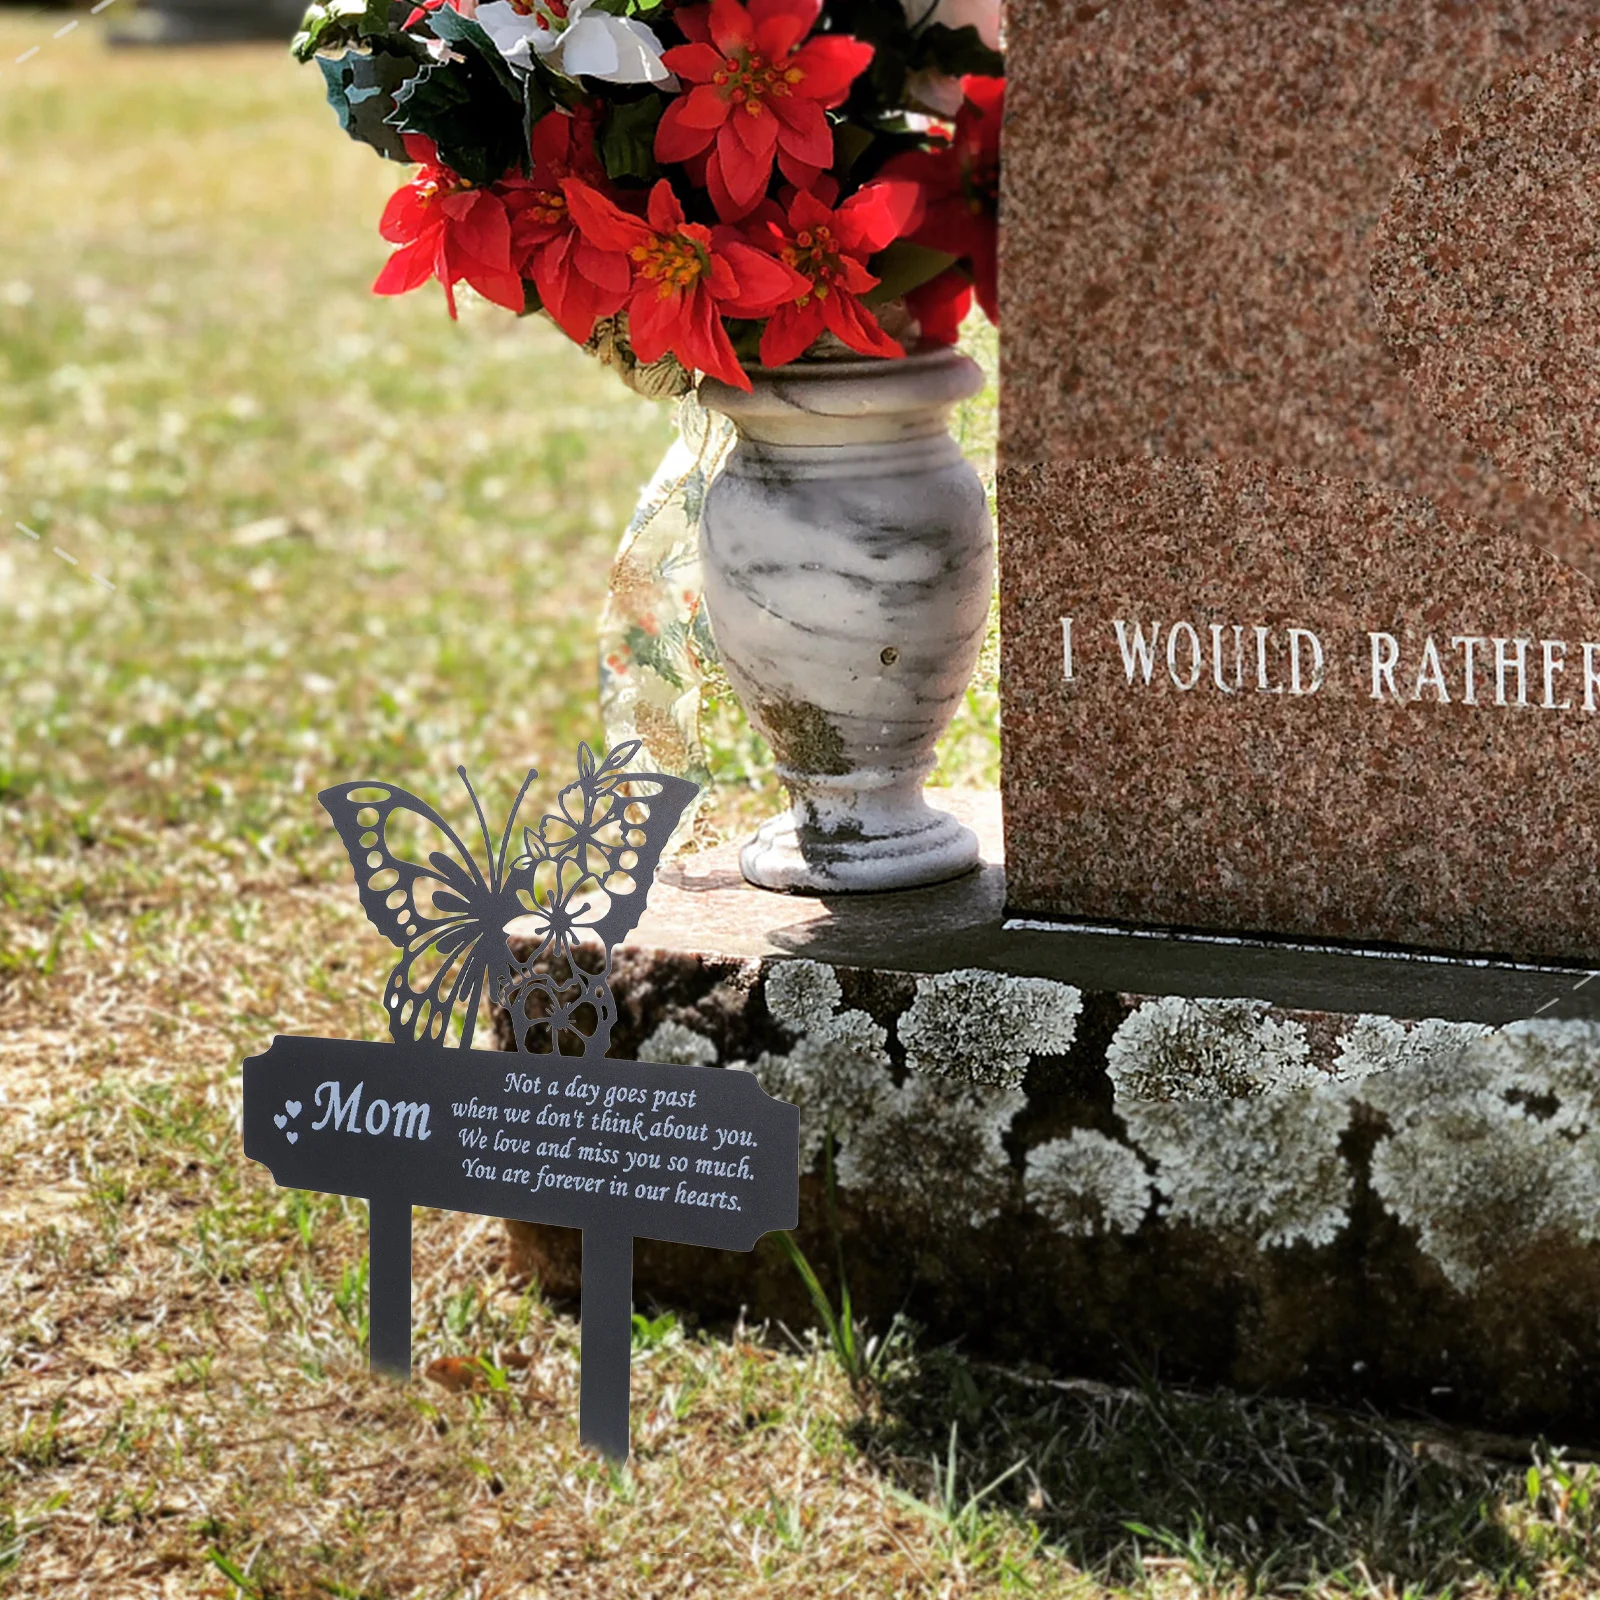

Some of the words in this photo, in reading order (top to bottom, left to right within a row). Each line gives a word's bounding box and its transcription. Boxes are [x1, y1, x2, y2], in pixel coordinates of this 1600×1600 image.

[1060, 616, 1075, 683] I
[1113, 619, 1324, 696] WOULD
[1367, 630, 1600, 712] RATHER
[311, 1080, 432, 1141] Mom
[503, 1072, 542, 1095] Not
[547, 1080, 560, 1096] a
[564, 1074, 601, 1106] day
[602, 1085, 648, 1108] goes
[650, 1089, 697, 1113] past
[451, 1096, 499, 1121] when
[503, 1107, 531, 1124] we
[535, 1103, 585, 1129] don't
[591, 1109, 649, 1142] think
[649, 1114, 709, 1142] about
[712, 1127, 758, 1151] you.
[458, 1126, 488, 1150] We
[493, 1129, 531, 1155] love
[536, 1136, 577, 1159] and
[577, 1141, 620, 1165] miss
[622, 1151, 662, 1173] you
[666, 1155, 689, 1172] so
[694, 1155, 755, 1181] much.
[461, 1157, 497, 1181] You
[502, 1168, 531, 1185] are
[530, 1164, 606, 1194] forever
[609, 1174, 629, 1197] in
[634, 1183, 671, 1202] our
[673, 1180, 742, 1212] hearts.
